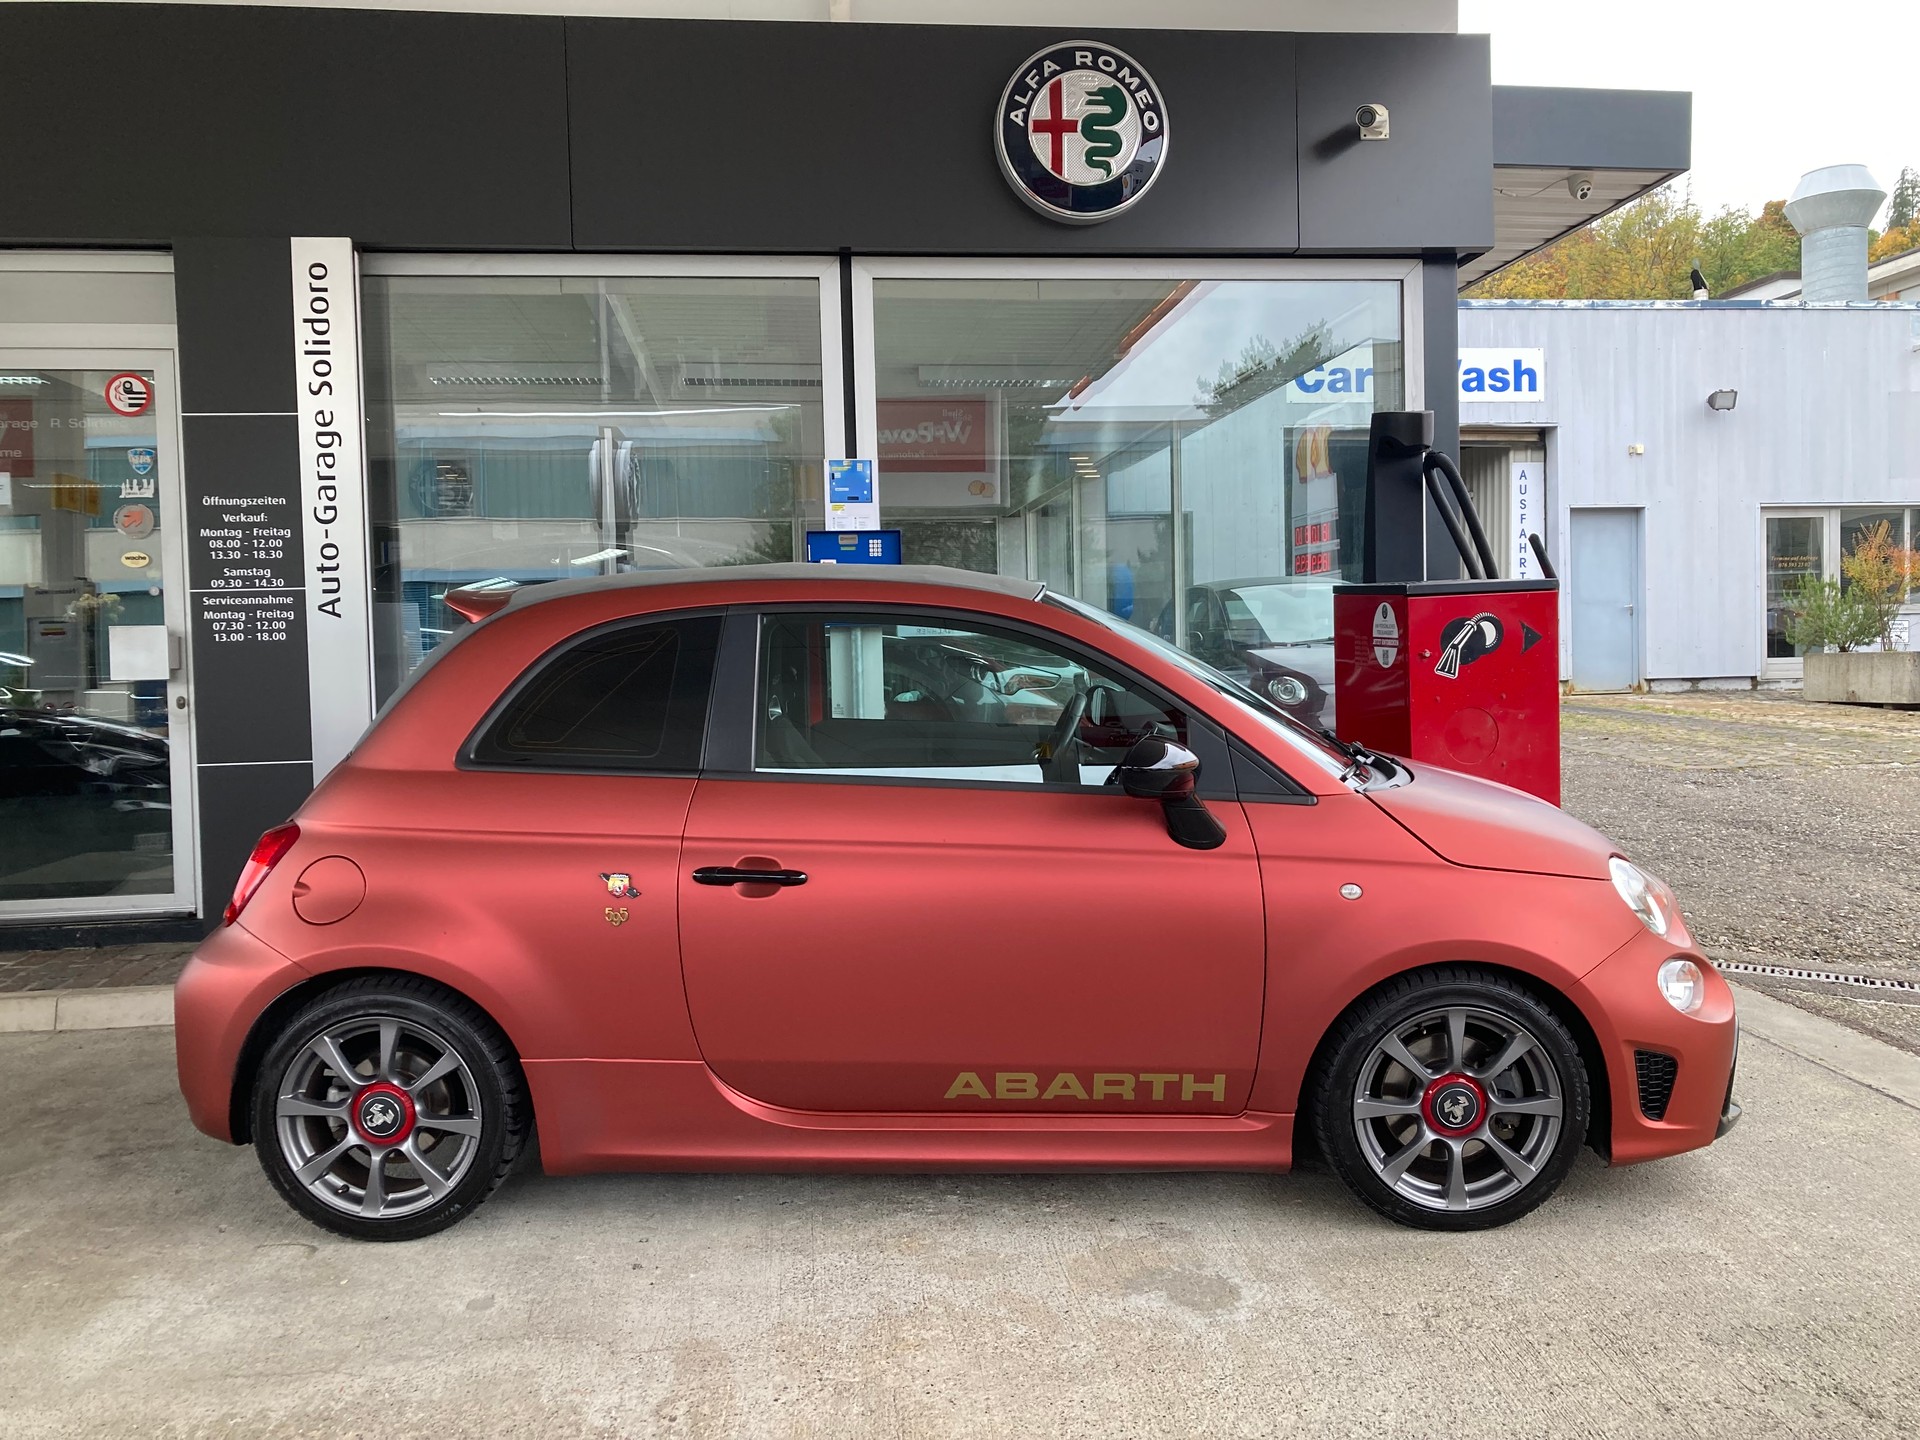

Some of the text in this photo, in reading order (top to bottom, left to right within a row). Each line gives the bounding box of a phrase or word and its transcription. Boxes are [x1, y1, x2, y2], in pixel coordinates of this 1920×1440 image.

[1010, 51, 1159, 133] ALFA ROMEO
[1458, 359, 1538, 393] ash
[302, 262, 342, 618] Auto-Garage Solidoro
[202, 495, 286, 508] Öffnungszeiten
[222, 512, 268, 522] Verkauf:
[200, 528, 242, 538] Montag
[253, 527, 291, 538] Freitag
[209, 539, 241, 548] 08.00
[252, 539, 283, 548] 12.00
[210, 550, 241, 559] 13.30
[252, 550, 283, 559] 18.30
[223, 567, 271, 578] Samstag
[210, 579, 242, 588] 09.30
[254, 578, 284, 588] 14.30
[202, 595, 294, 605] Serviceannahme
[203, 611, 246, 621] Montag
[256, 609, 295, 620] Freitag
[212, 621, 244, 631] 07.30
[255, 621, 286, 630] 12.00
[213, 633, 245, 642] 13.00
[255, 632, 286, 641] 18.00
[604, 907, 629, 927] 595
[943, 1071, 1226, 1102] ABARTH
